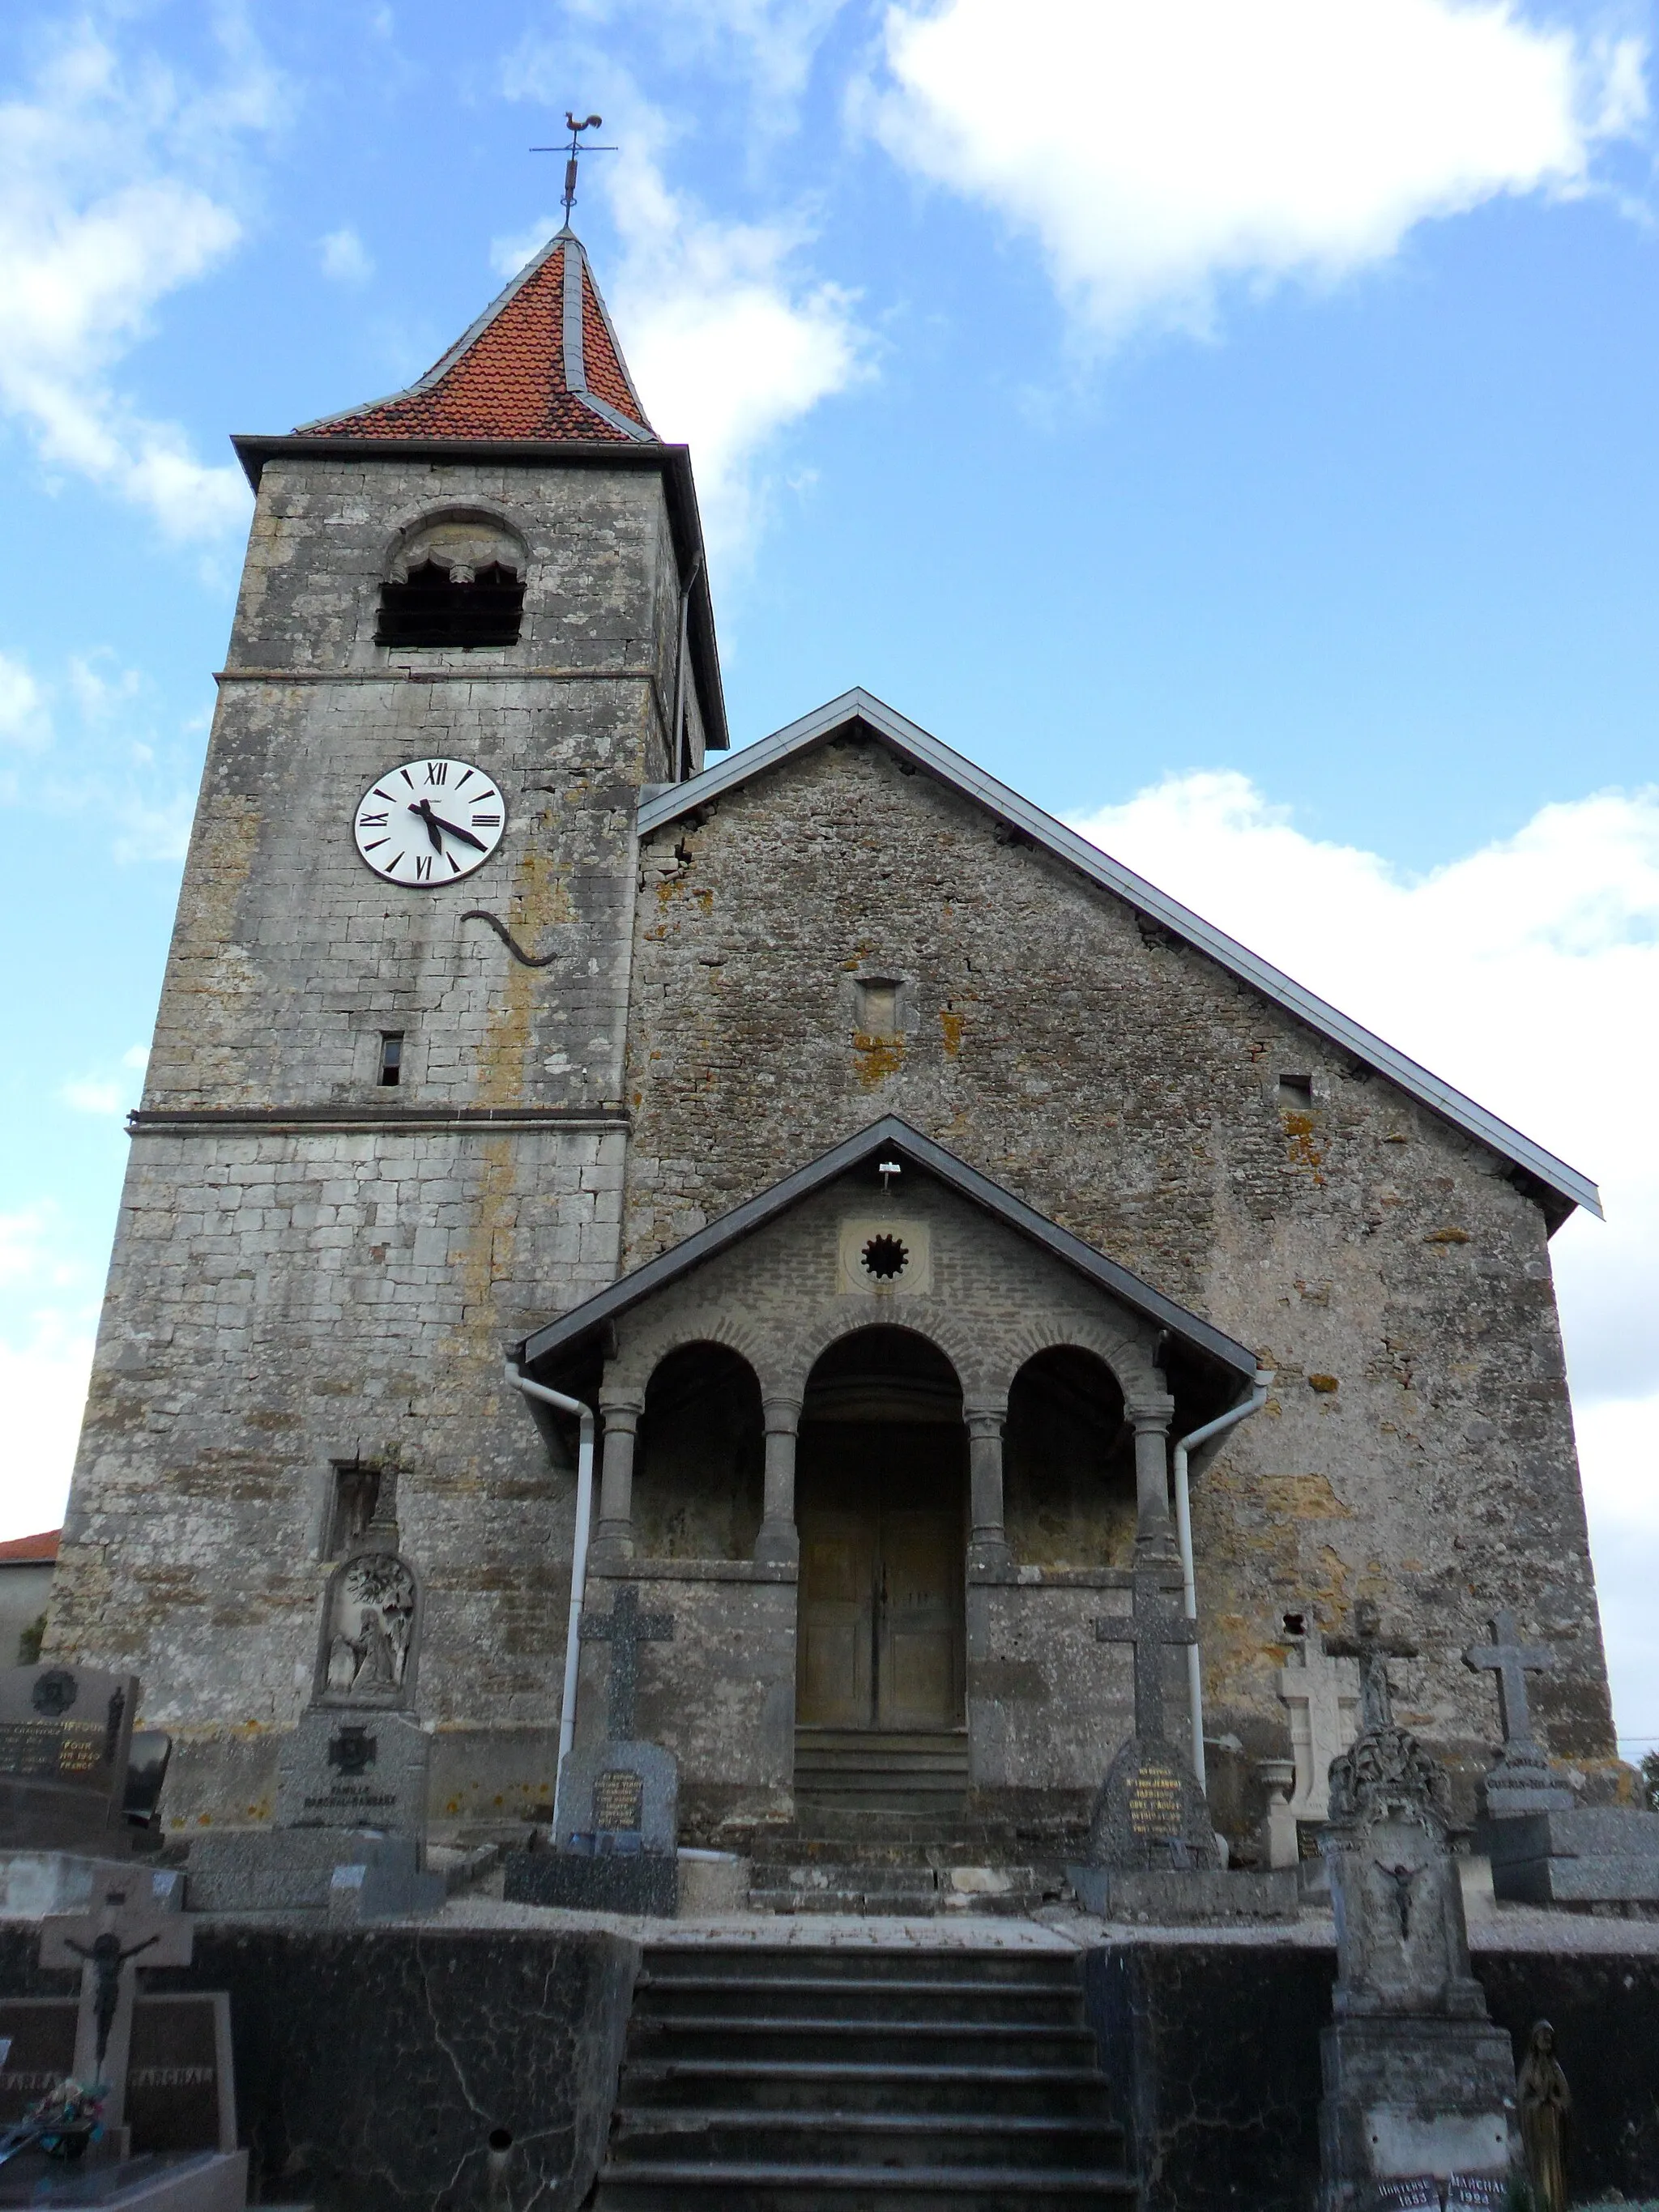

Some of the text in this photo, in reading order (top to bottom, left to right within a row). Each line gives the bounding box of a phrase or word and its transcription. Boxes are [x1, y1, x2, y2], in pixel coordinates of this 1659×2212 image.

[424, 762, 448, 786] XII
[471, 815, 501, 827] III
[416, 856, 433, 880] VI
[1378, 2178, 1430, 2197] HORTENSE
